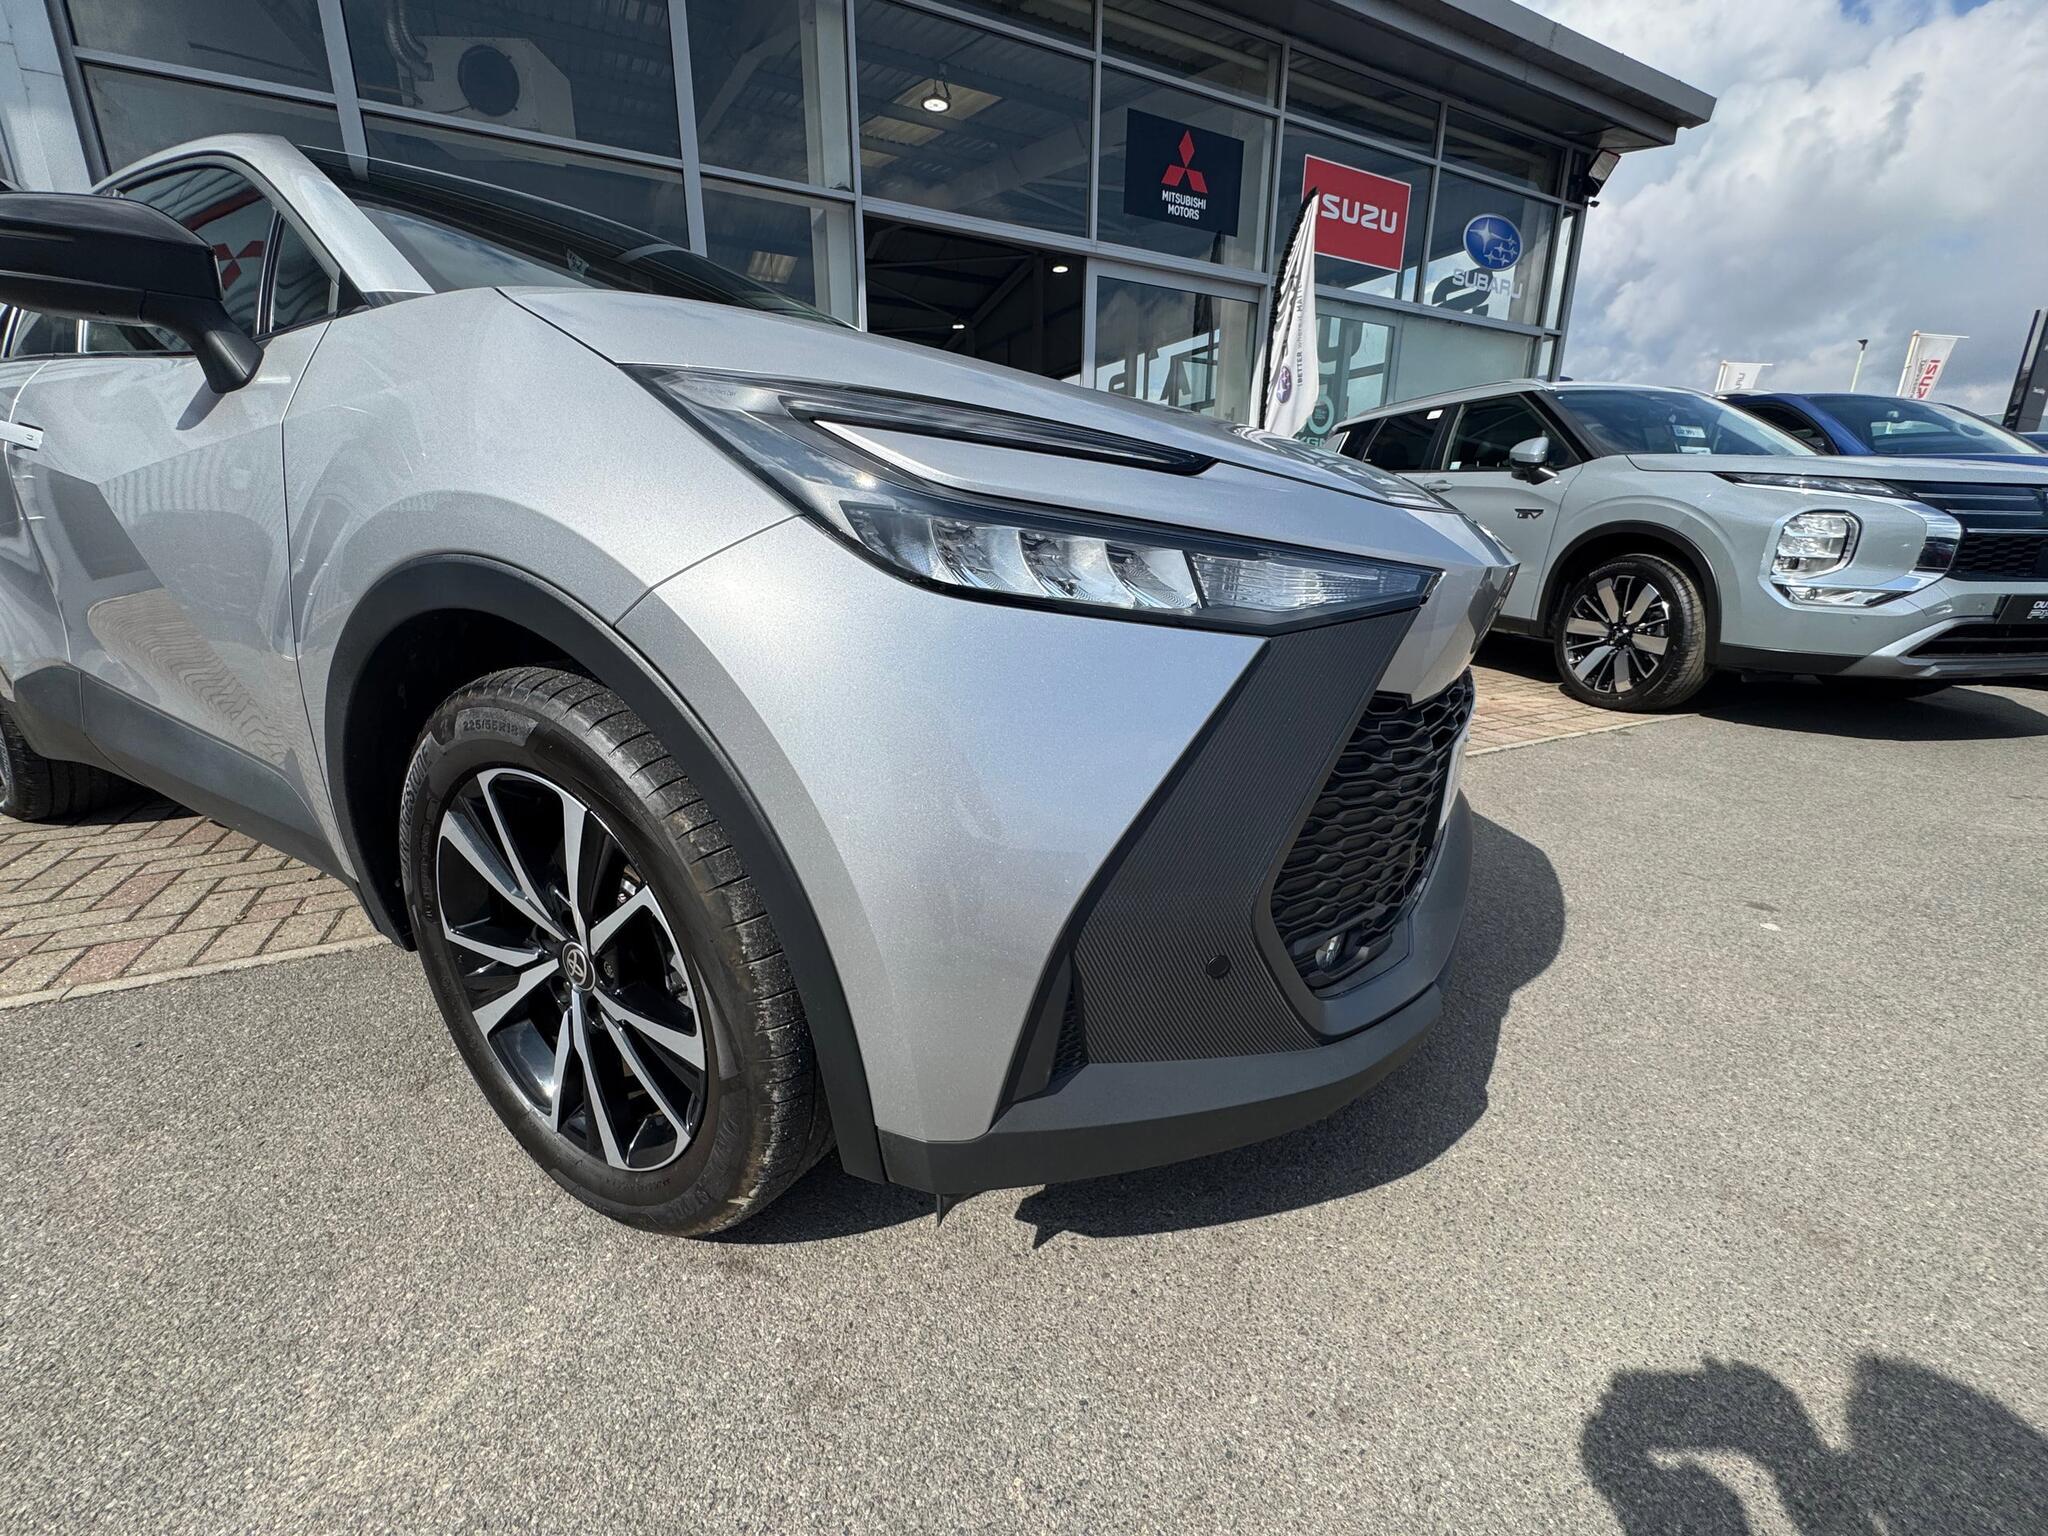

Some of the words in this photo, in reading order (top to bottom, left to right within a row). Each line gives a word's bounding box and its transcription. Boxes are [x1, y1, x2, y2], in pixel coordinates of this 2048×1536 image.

[1162, 189, 1207, 210] MITSUBISHI
[1167, 203, 1200, 221] MOTORS
[1317, 192, 1398, 234] SUZU
[1452, 268, 1524, 299] SUBARU
